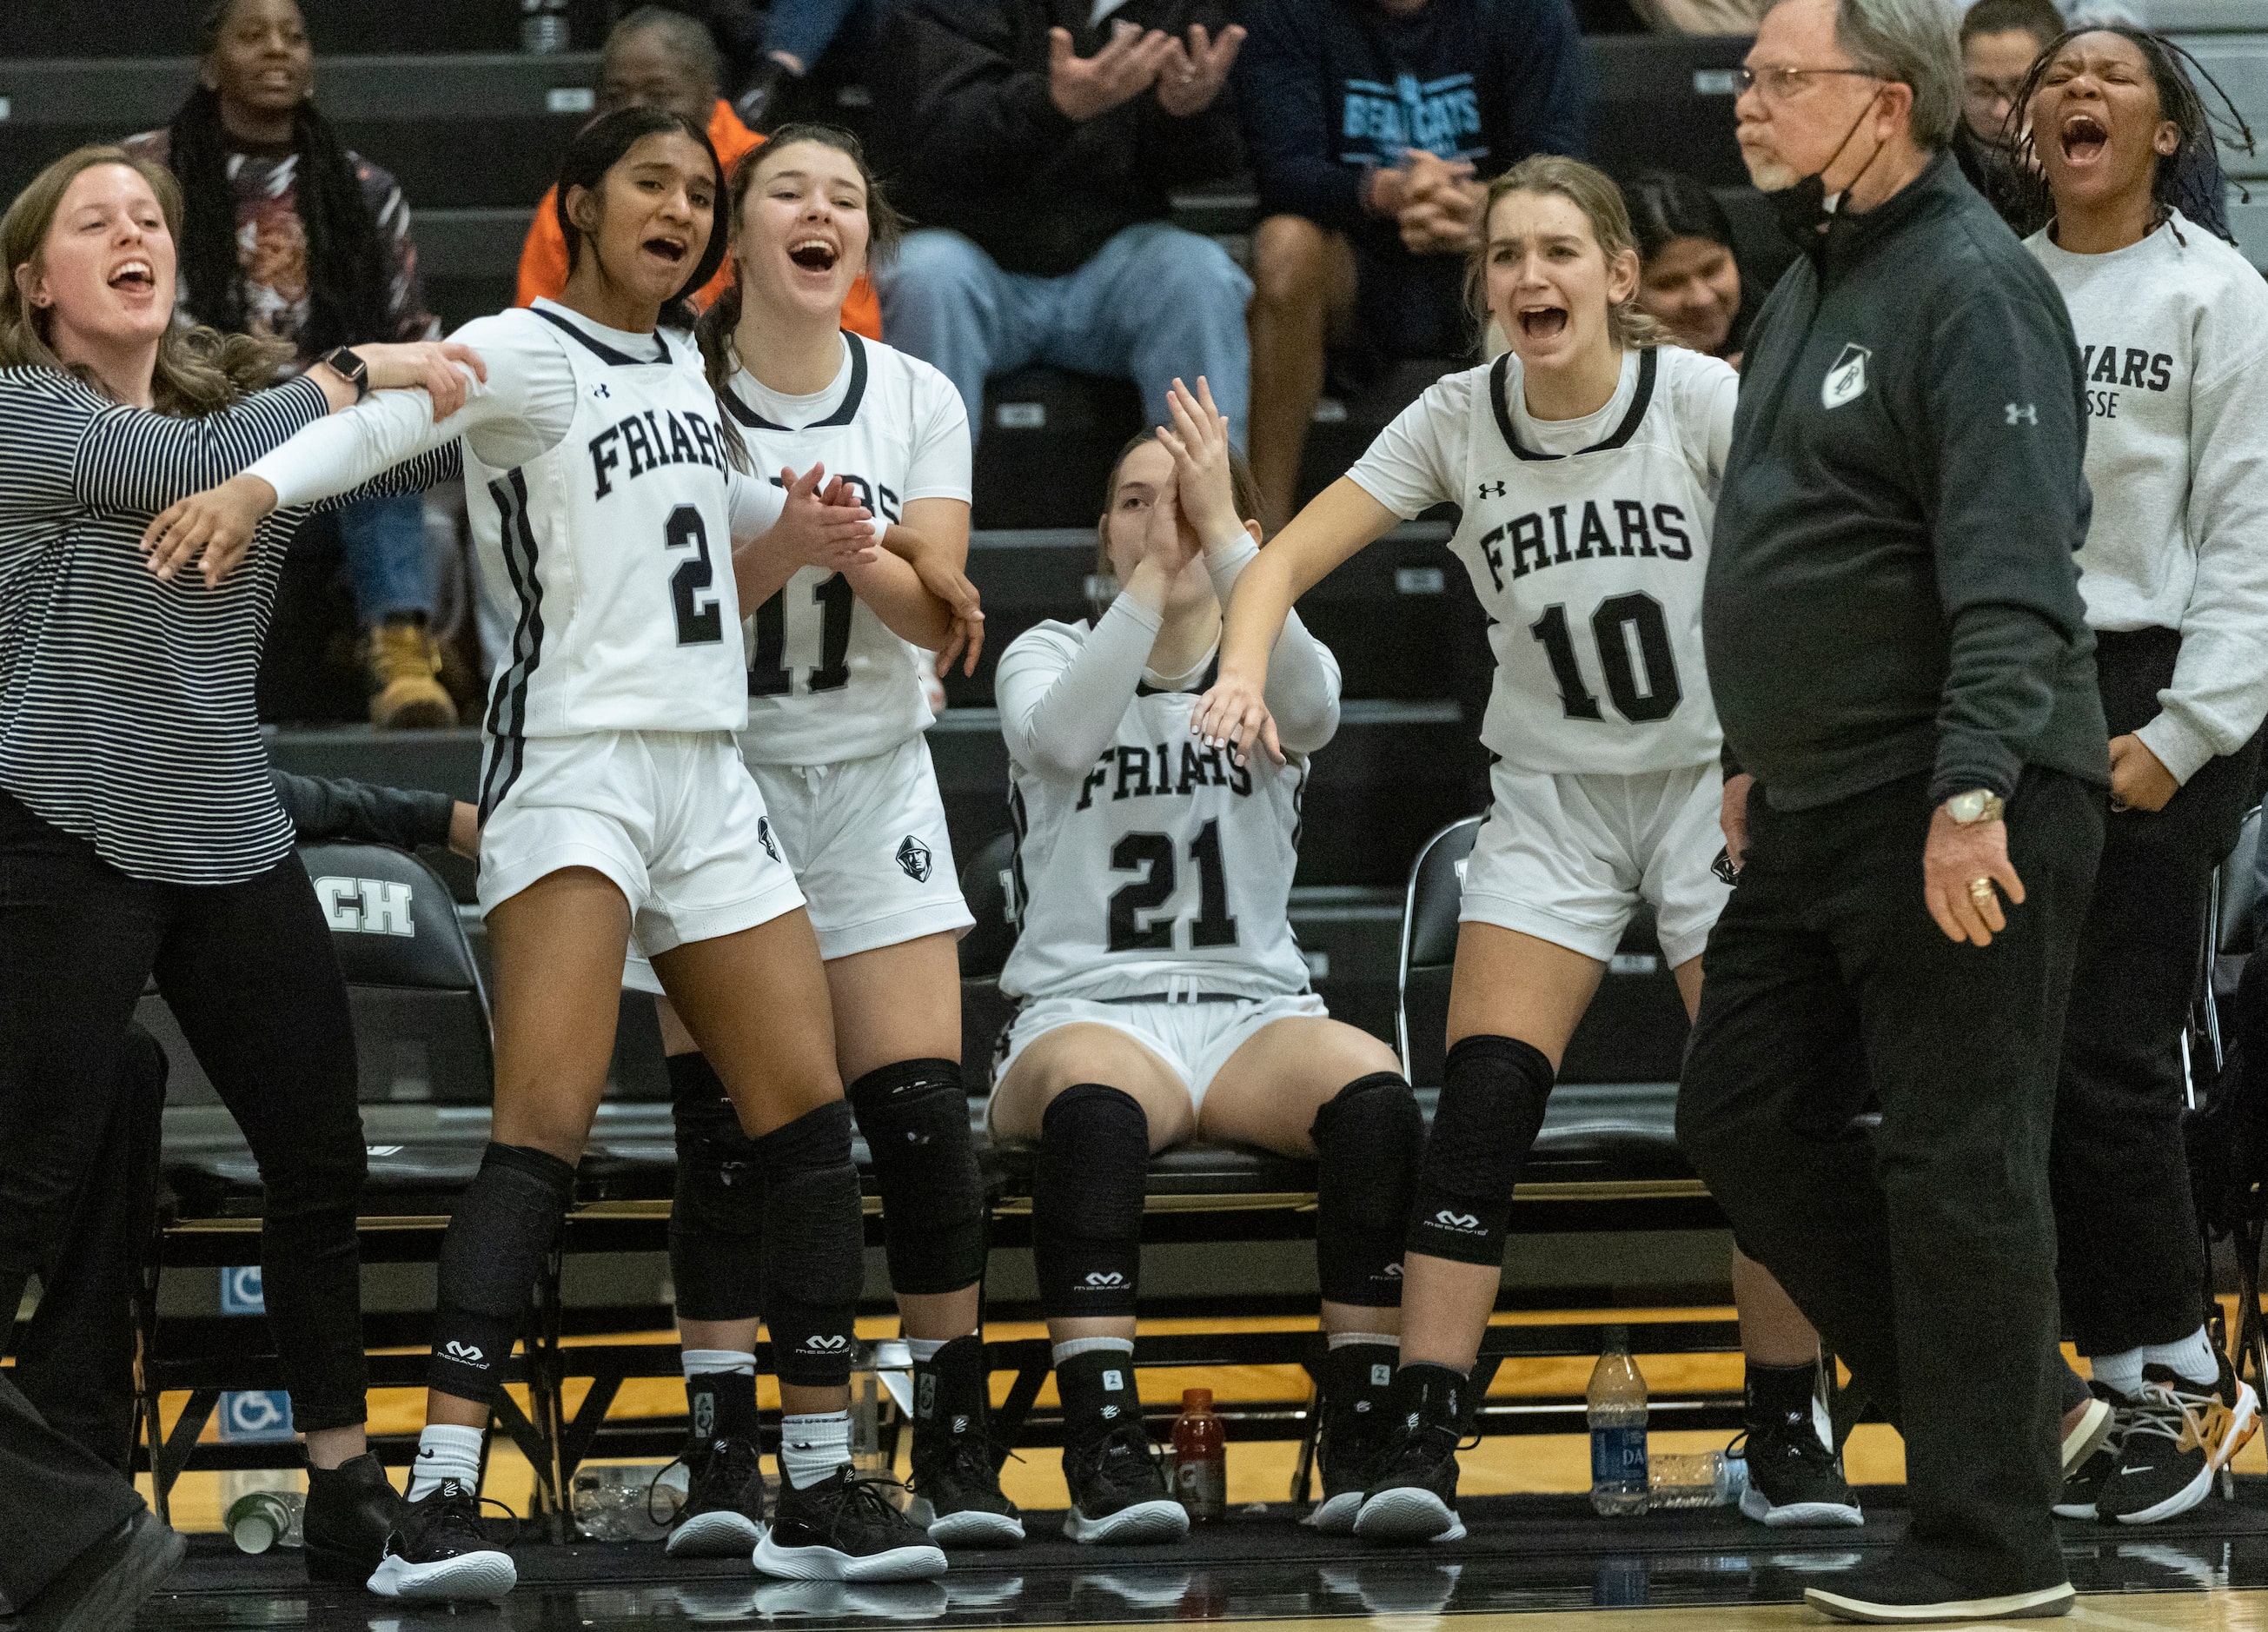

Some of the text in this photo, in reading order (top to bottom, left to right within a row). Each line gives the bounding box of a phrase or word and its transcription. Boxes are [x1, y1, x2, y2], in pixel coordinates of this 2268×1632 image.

[1344, 90, 1482, 144] BEACATS
[663, 503, 723, 647] 2
[1479, 499, 1693, 594] FRIARS
[747, 570, 852, 699] 11
[1529, 589, 1684, 726] 10
[309, 875, 414, 938] CH
[1104, 815, 1240, 953] 21
